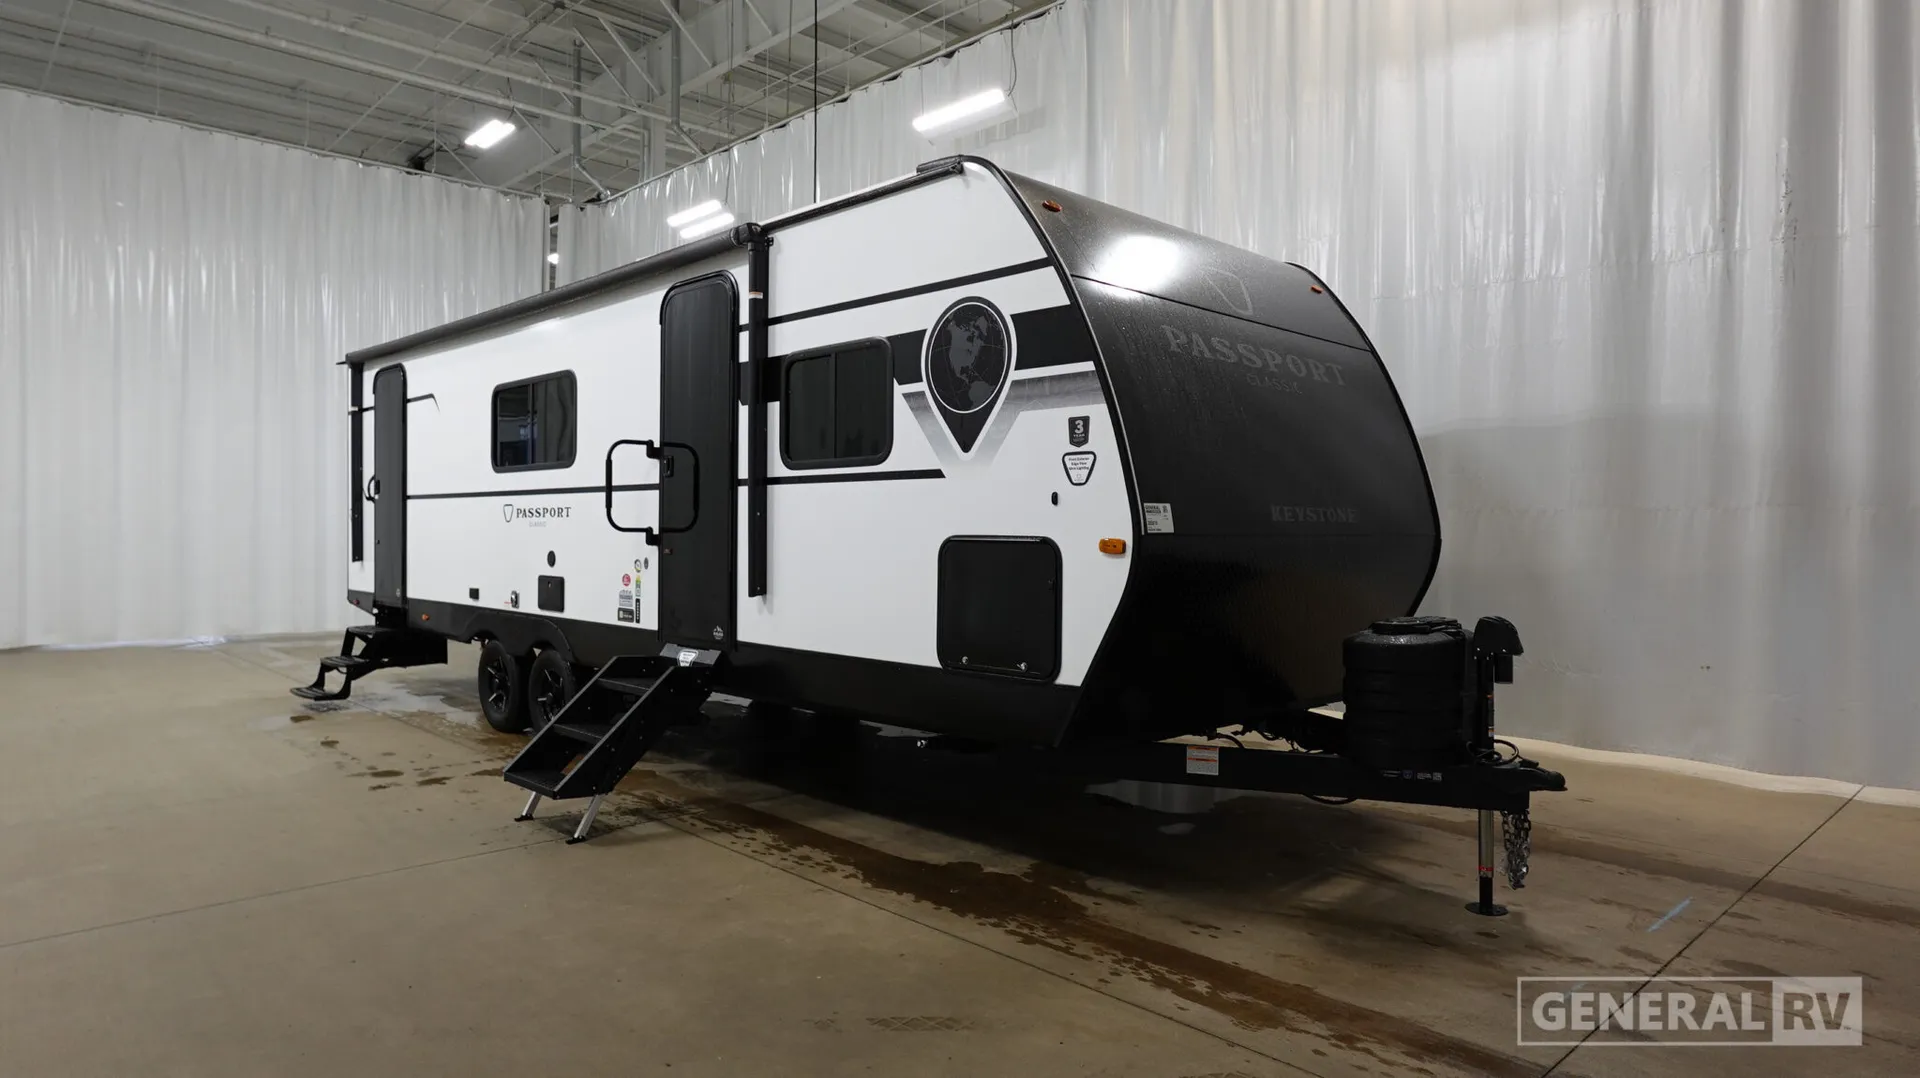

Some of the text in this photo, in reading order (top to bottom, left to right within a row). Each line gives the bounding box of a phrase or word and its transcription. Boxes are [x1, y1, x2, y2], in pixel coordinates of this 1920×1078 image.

[1160, 324, 1347, 387] PASSPORT
[1074, 419, 1084, 434] 3
[516, 506, 572, 519] PASSPORT
[1270, 503, 1359, 524] KEYSTONE
